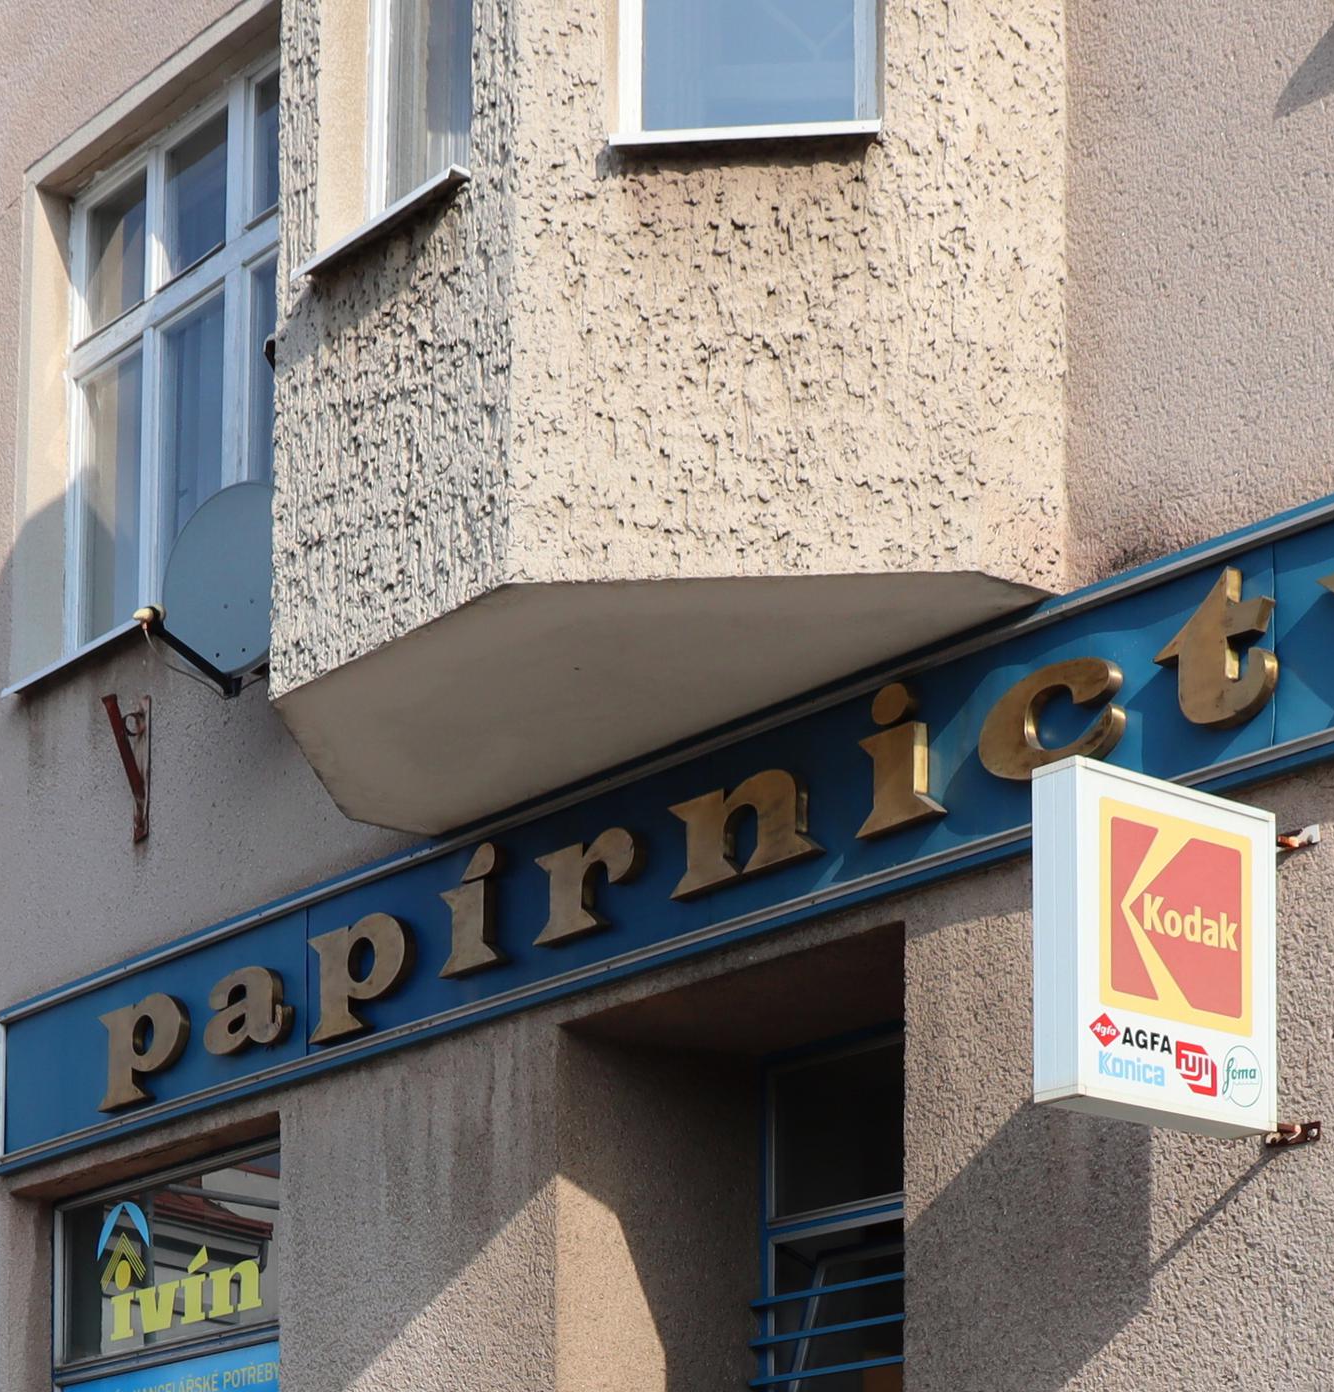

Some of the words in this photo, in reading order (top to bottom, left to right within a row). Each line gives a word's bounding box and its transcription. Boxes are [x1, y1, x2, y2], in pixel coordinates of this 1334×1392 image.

[1143, 891, 1239, 952] Kodak
[1092, 1020, 1118, 1038] Agfa
[1121, 1026, 1172, 1055] AGFA
[1098, 1050, 1165, 1087] Konica
[1223, 1058, 1257, 1096] foma
[110, 1245, 262, 1342] ivín
